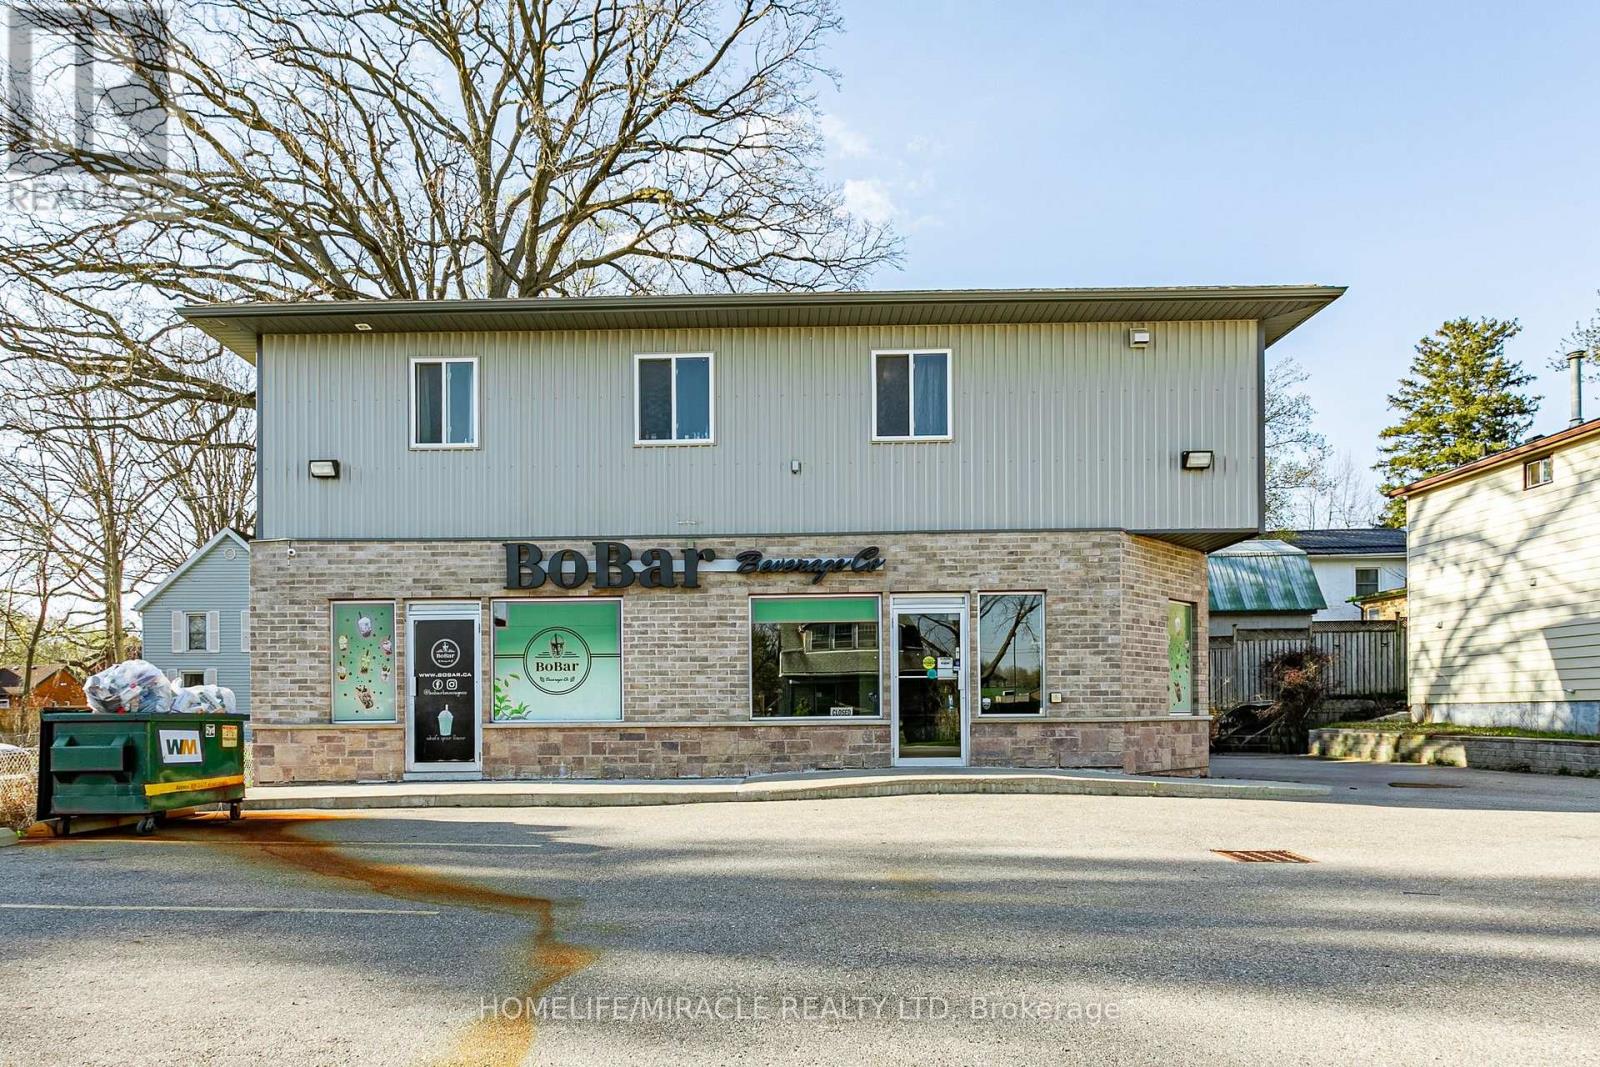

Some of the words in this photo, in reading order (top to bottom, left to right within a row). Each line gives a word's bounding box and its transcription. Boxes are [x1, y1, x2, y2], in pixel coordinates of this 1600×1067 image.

[502, 541, 716, 590] BoBar
[736, 550, 850, 585] Beverage
[850, 546, 887, 573] Co
[536, 661, 579, 672] BoBar
[166, 738, 197, 755] WM
